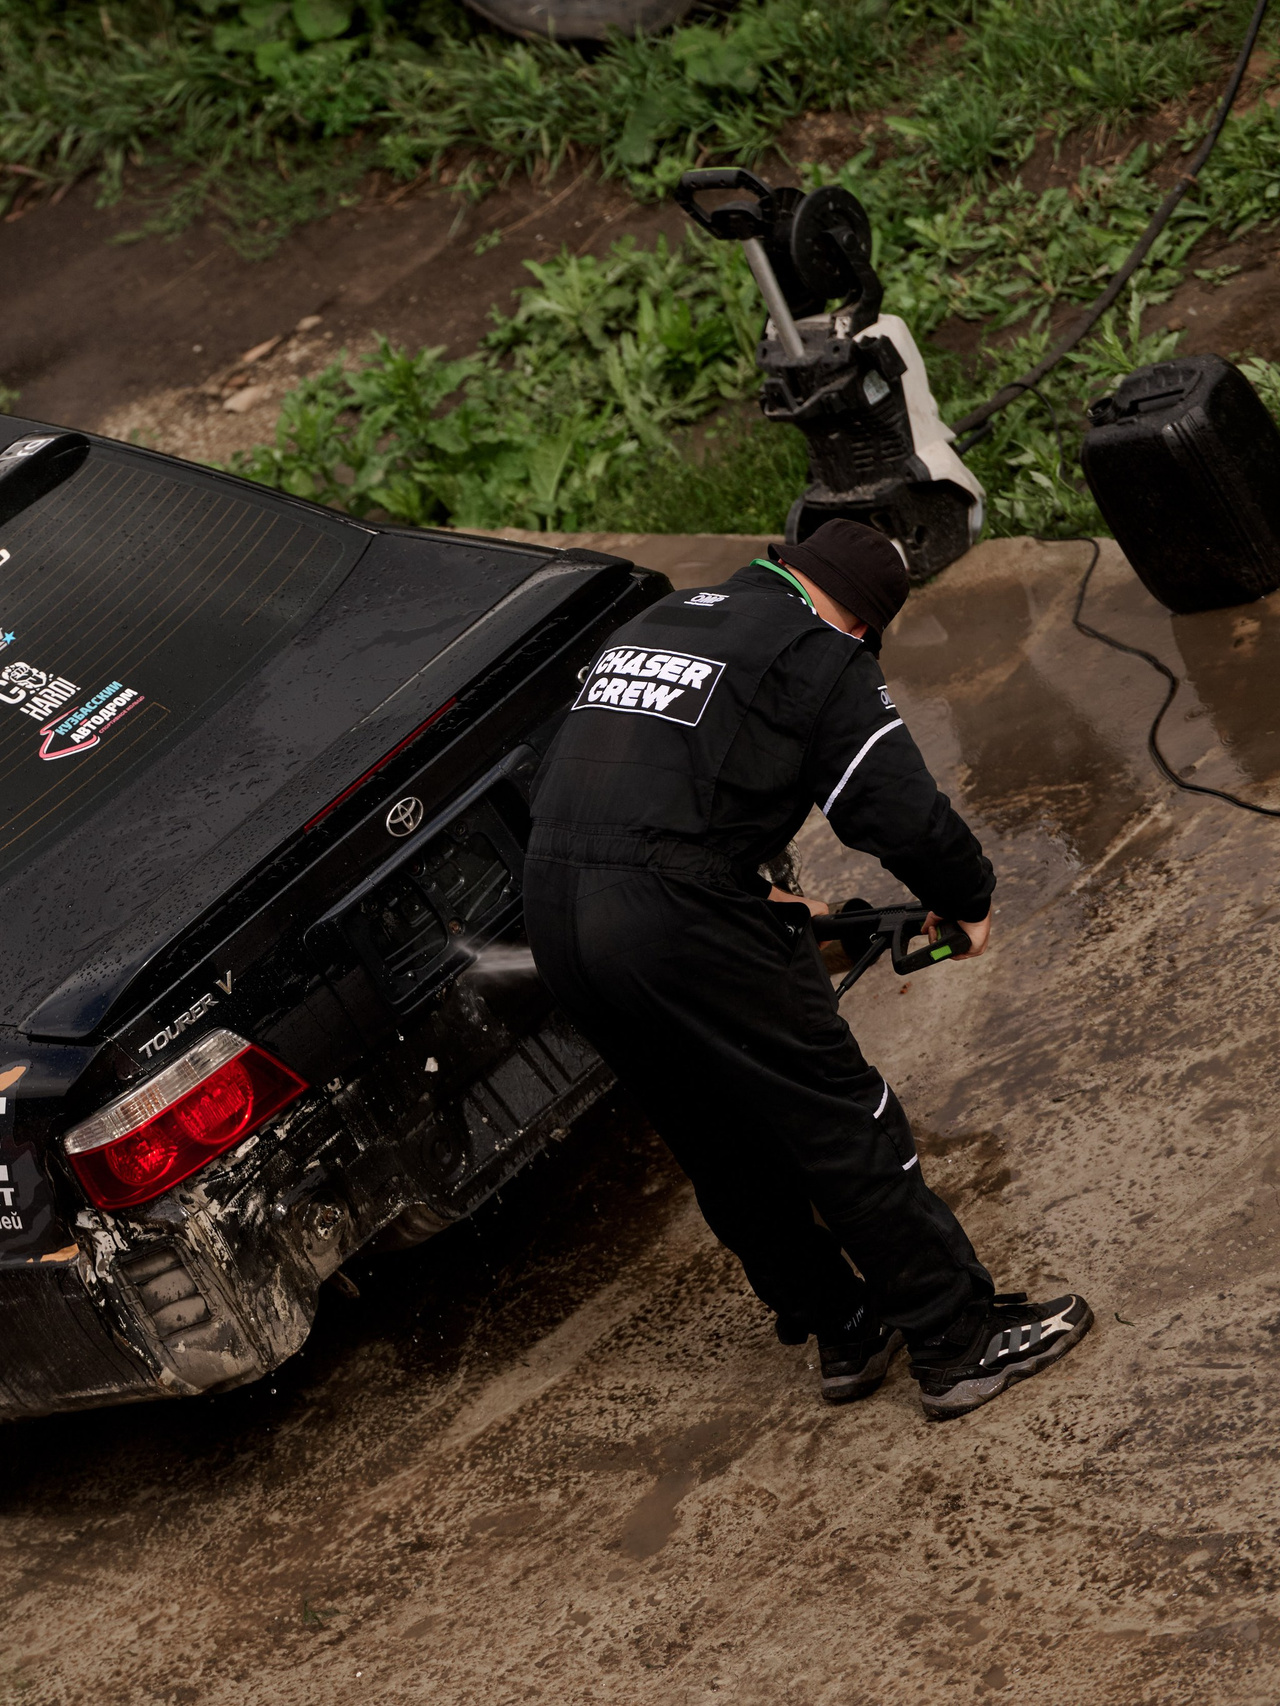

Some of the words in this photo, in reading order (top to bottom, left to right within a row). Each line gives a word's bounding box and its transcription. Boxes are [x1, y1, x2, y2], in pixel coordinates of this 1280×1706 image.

[595, 650, 713, 690] CHASER
[19, 676, 82, 722] HARD!
[70, 687, 139, 744] АВТОДРОМ
[587, 677, 685, 712] CREW
[138, 992, 219, 1059] TOURER
[214, 969, 232, 995] V
